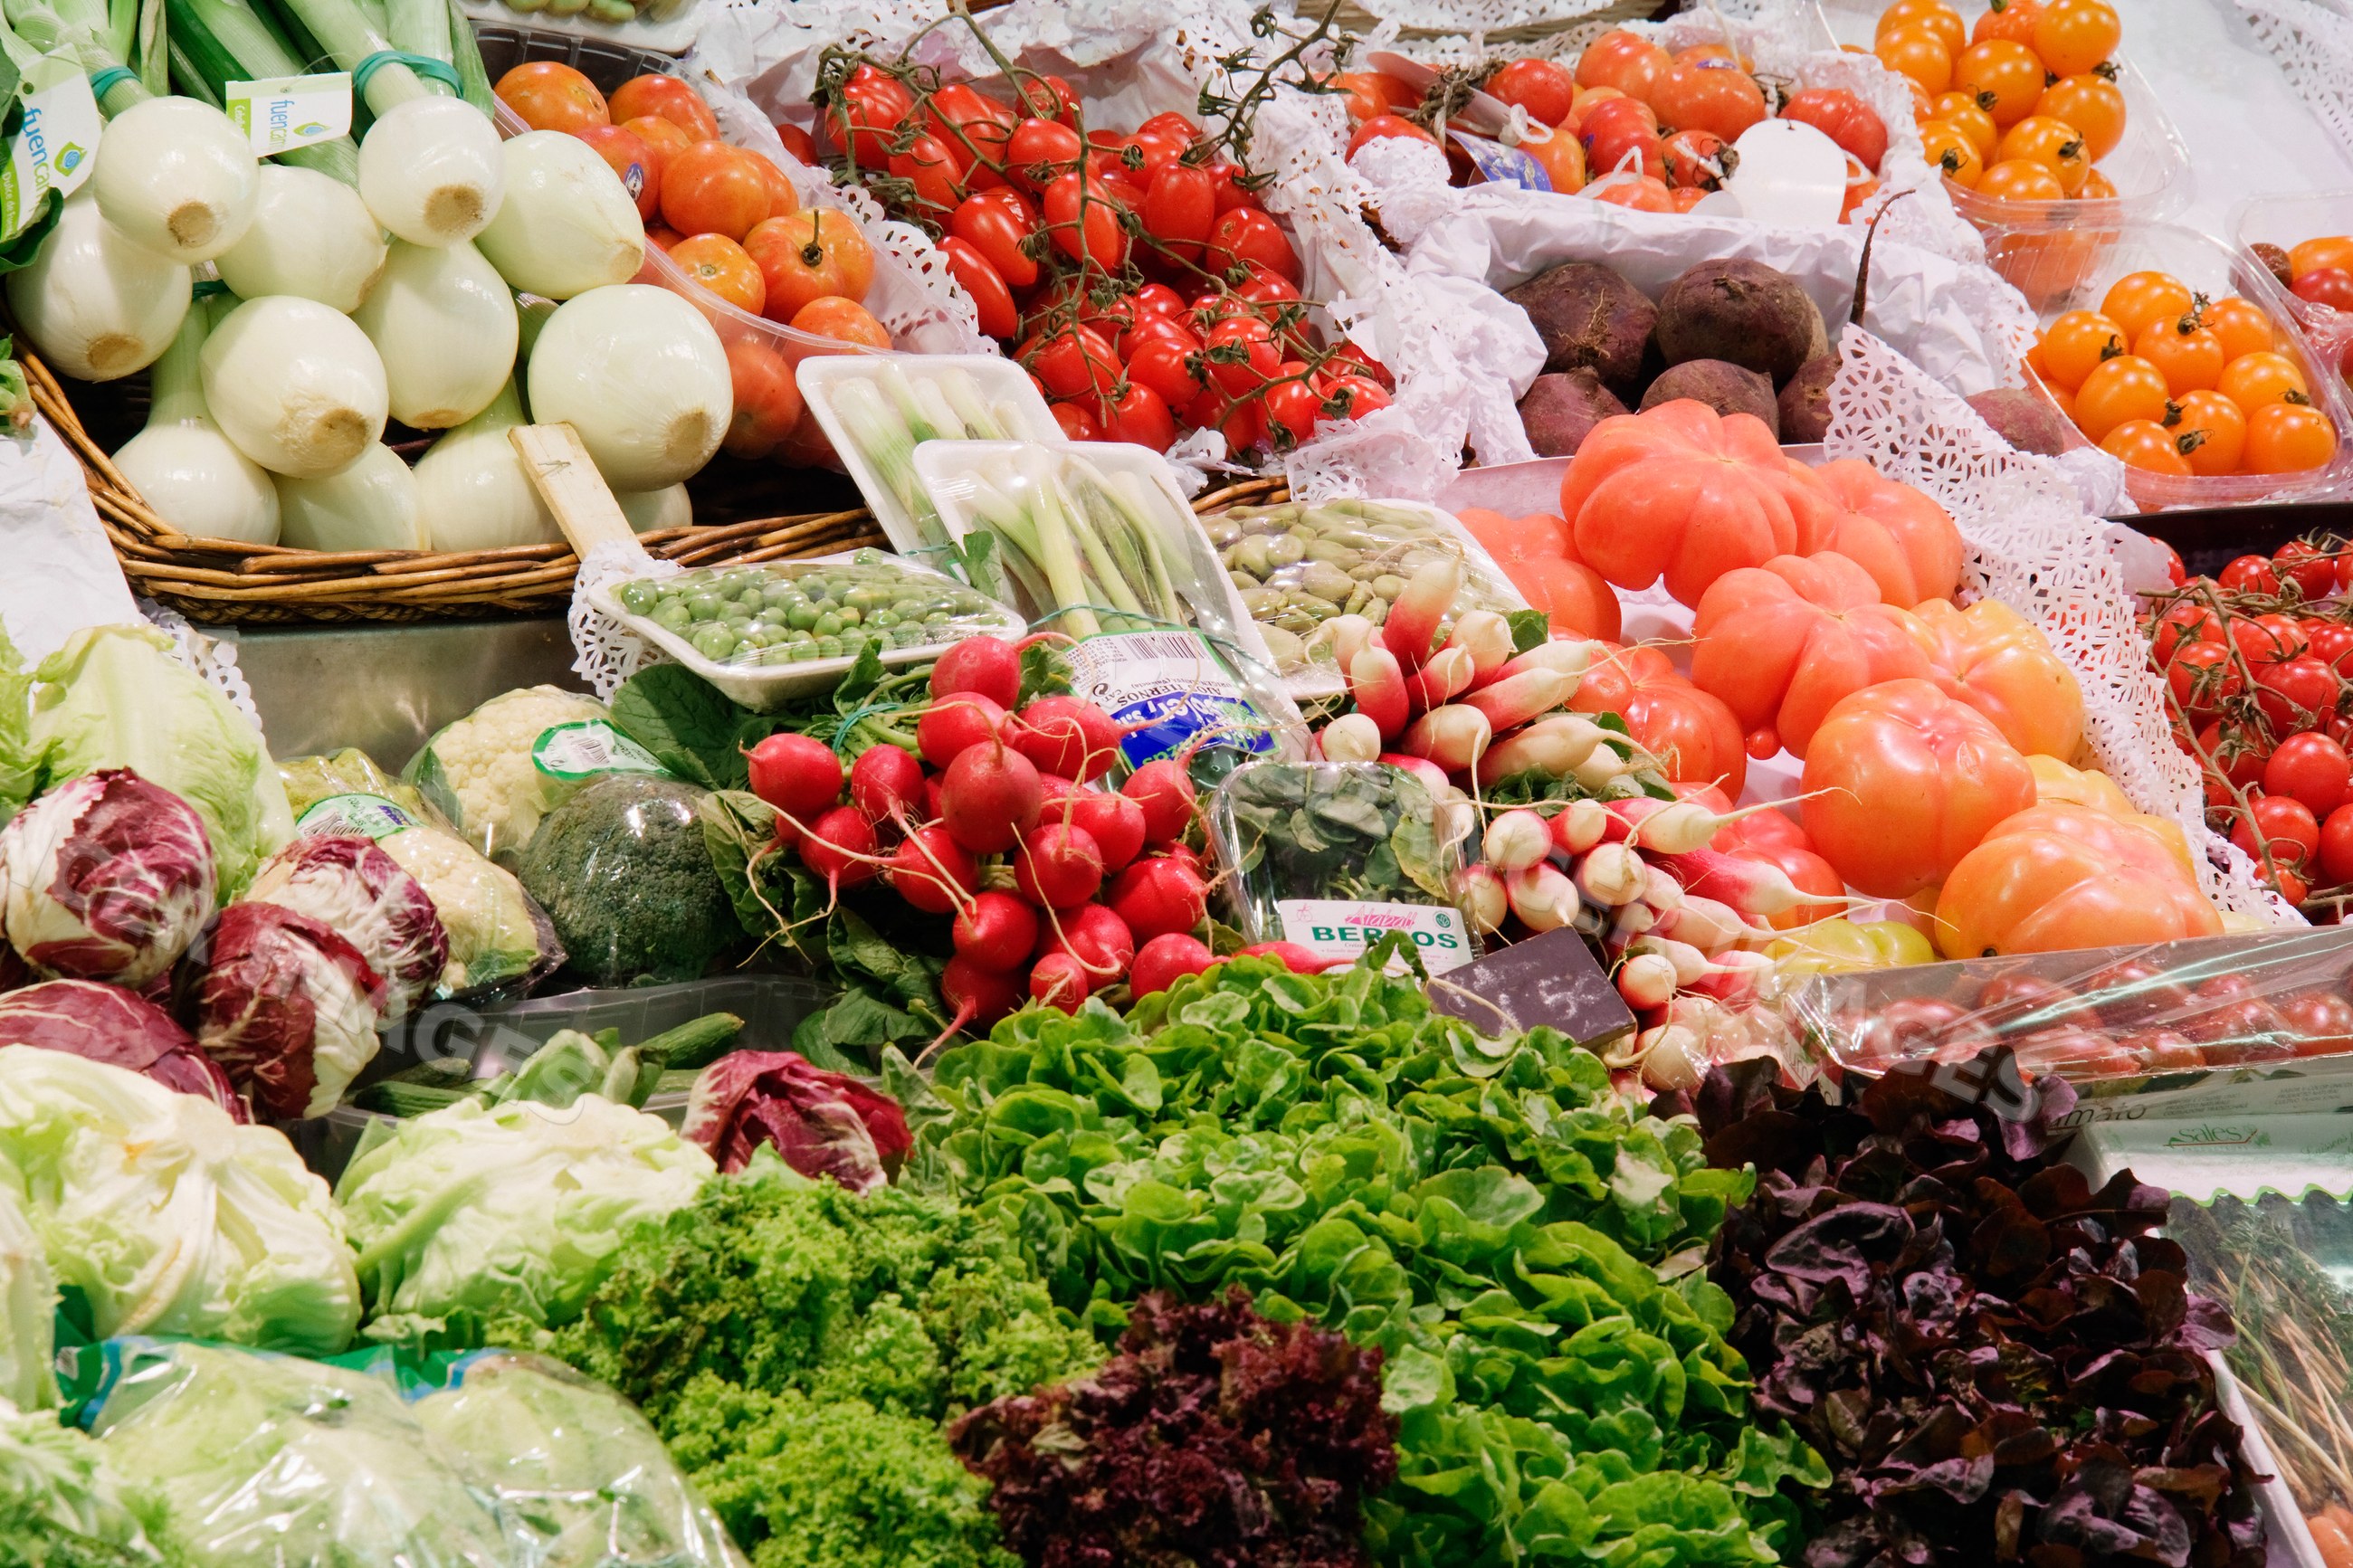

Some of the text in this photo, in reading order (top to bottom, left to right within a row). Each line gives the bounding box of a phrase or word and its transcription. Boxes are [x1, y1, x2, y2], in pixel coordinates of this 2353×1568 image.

[1117, 680, 1192, 707] TIERNOS
[1311, 926, 1459, 949] BEROS
[2178, 1124, 2243, 1143] sales
